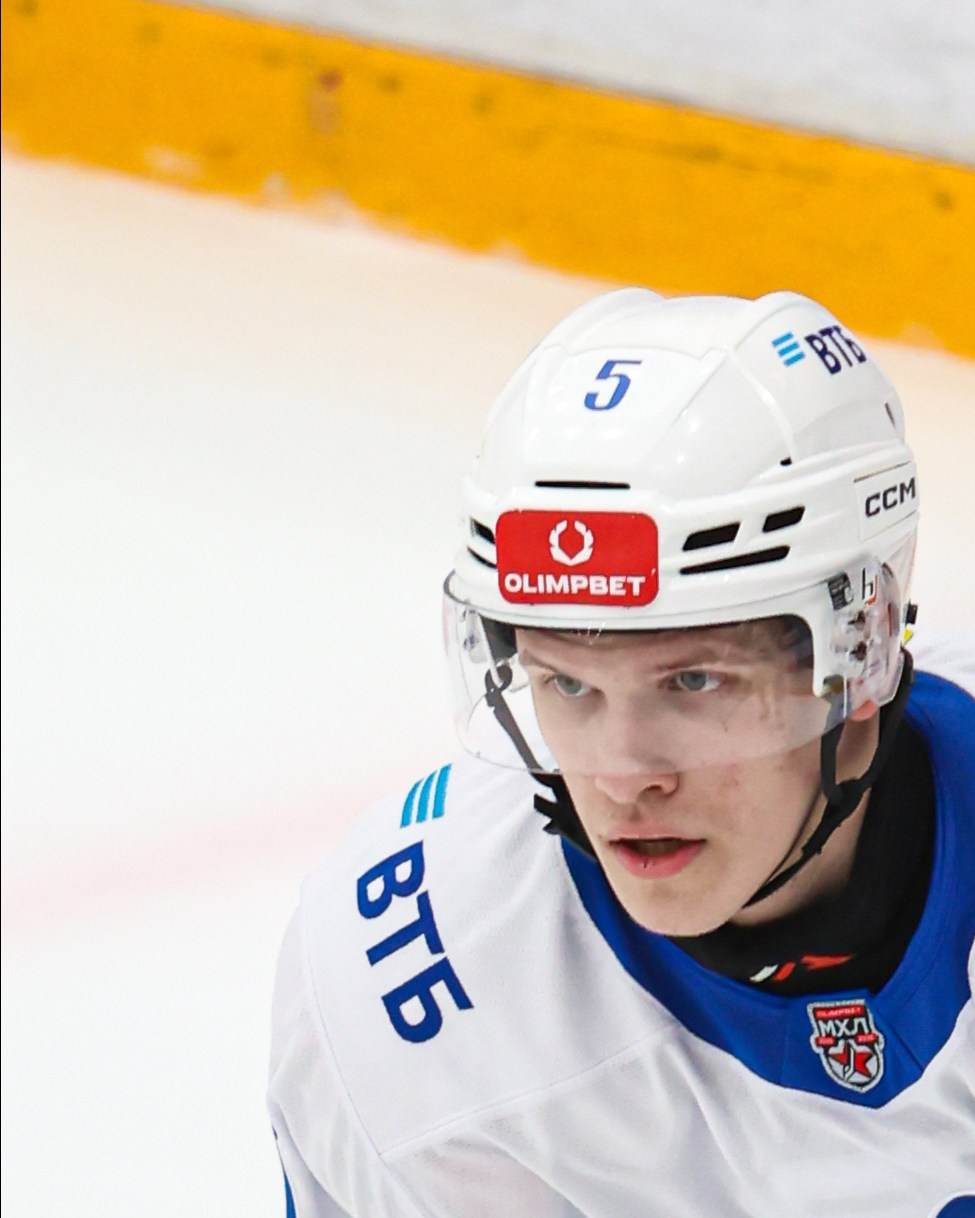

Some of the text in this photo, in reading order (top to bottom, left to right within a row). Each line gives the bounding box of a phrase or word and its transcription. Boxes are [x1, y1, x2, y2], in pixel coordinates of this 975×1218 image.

[804, 325, 867, 375] ВТБ
[583, 359, 643, 412] 5
[865, 477, 916, 518] CCM
[504, 572, 646, 597] OLIMPBET
[356, 840, 475, 1043] ВТБ
[817, 1017, 869, 1038] МХЛ
